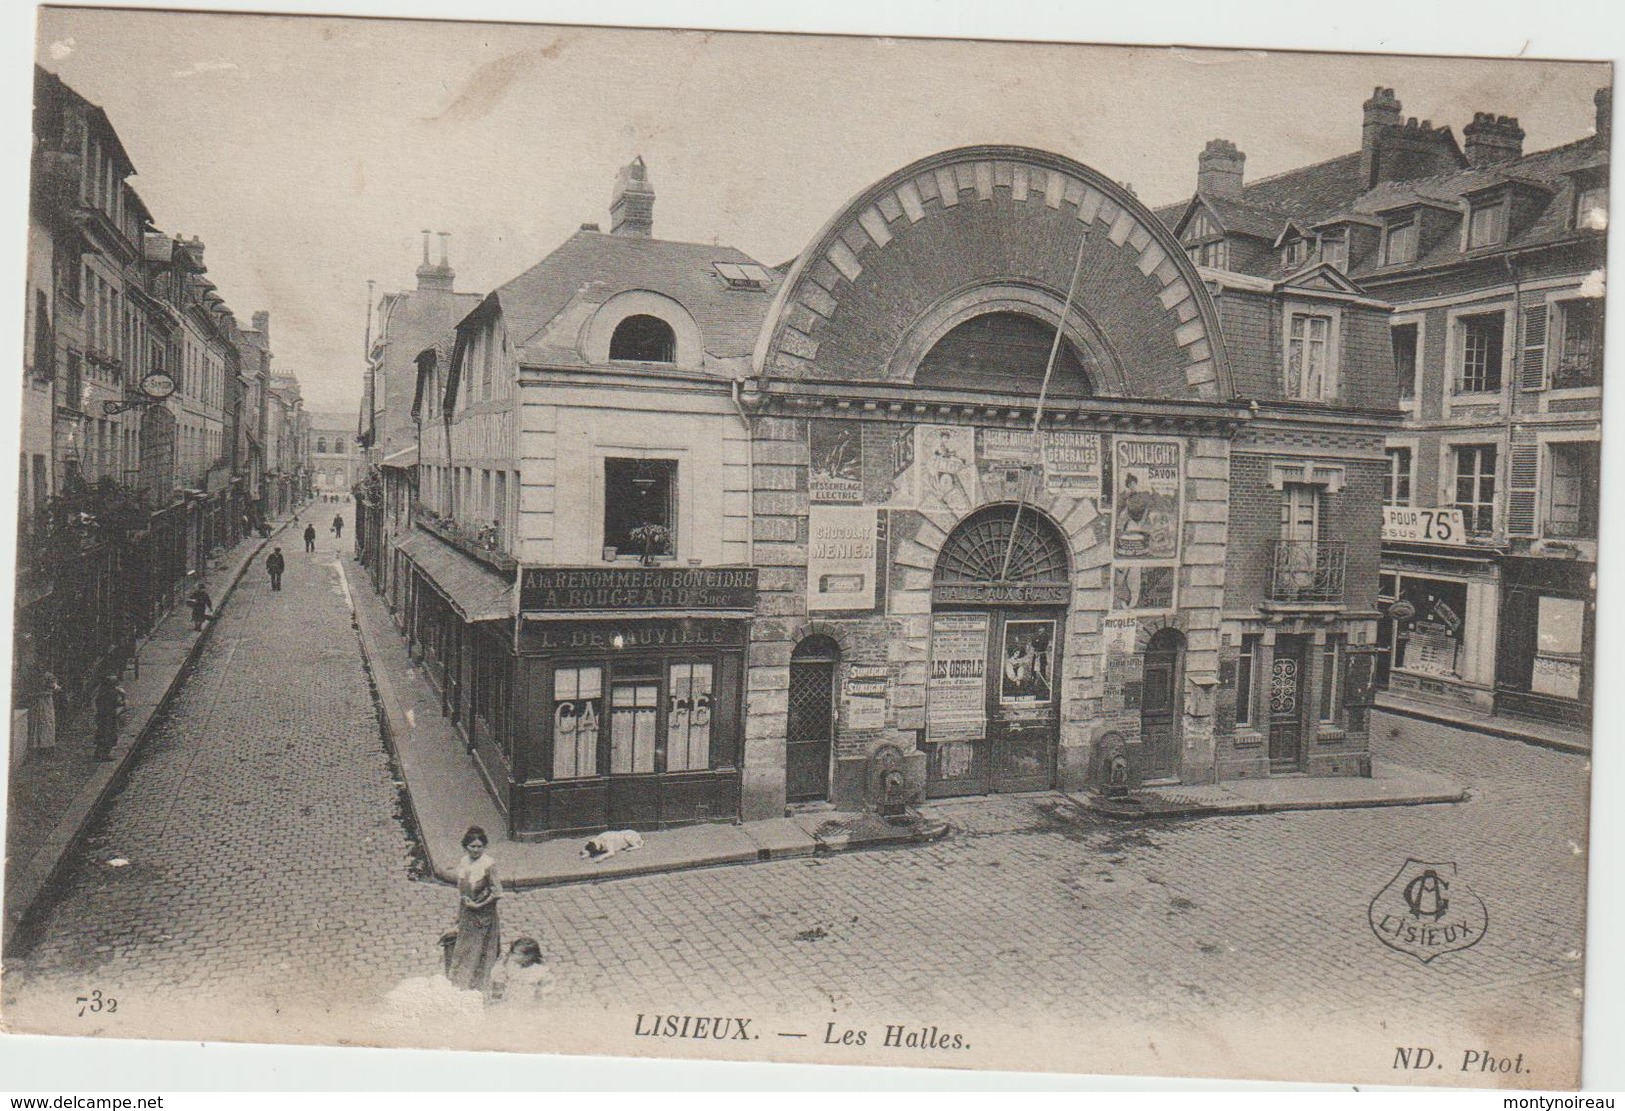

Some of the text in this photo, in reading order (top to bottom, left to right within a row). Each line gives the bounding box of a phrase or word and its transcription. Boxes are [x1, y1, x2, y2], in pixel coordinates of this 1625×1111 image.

[1118, 442, 1177, 467] SUNLIGHT
[1148, 467, 1177, 480] SAVON
[810, 481, 862, 492] RESSEMELAGE
[815, 491, 859, 500] ELECTRIC
[1390, 512, 1418, 526] POUR
[816, 525, 872, 541] CHOCOLAT
[812, 542, 874, 560] MENIER
[672, 569, 705, 588] BON
[705, 569, 754, 588] CIDRE
[939, 586, 1062, 600] HALLE AUX GRAINS
[850, 665, 889, 679] SUNLIGHT
[931, 660, 947, 679] LES
[847, 682, 886, 695] SUNLIGHT
